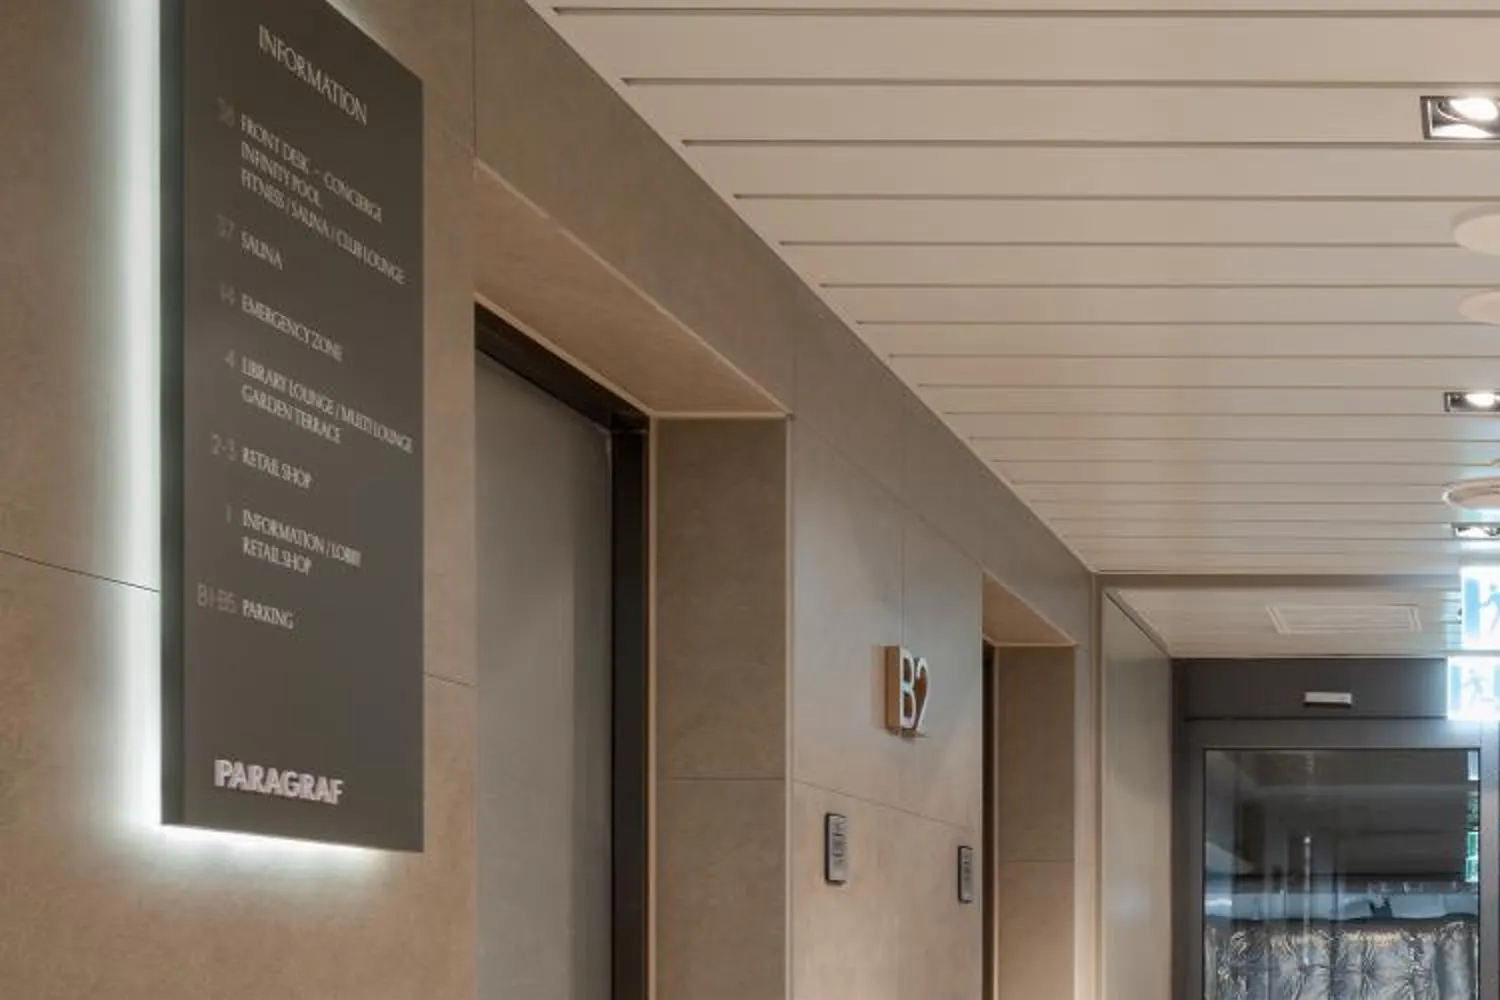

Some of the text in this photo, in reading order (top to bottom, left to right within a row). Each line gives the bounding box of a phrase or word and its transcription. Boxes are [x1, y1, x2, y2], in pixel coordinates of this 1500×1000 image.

[259, 23, 367, 126] INFORMATION
[241, 112, 280, 154] FRONT
[283, 143, 309, 174] DESK
[323, 172, 383, 224] CONCIERGE
[241, 141, 322, 208] INFINITY POOL
[241, 168, 285, 209] FITNESS
[291, 200, 330, 237] SAUNA
[336, 230, 362, 260] CLUB
[362, 246, 405, 284] LOUNGE
[241, 231, 283, 271] SAUNA
[241, 293, 311, 343] EMERGENCY
[312, 330, 343, 362] ZONE
[225, 350, 236, 368] 4
[241, 356, 288, 393] LIBRARY
[289, 379, 334, 416] LOUNGE
[341, 406, 373, 435] MULTI
[373, 422, 413, 454] LOUNGE
[241, 384, 341, 444] GARDEN TERRACE
[242, 447, 280, 479] RETAIL
[281, 464, 313, 488] SHOP
[242, 509, 325, 553] INFORMATION
[242, 536, 313, 576] RETAIL SHOP
[242, 599, 294, 629] PARKING
[214, 758, 344, 805] PARAGRAF
